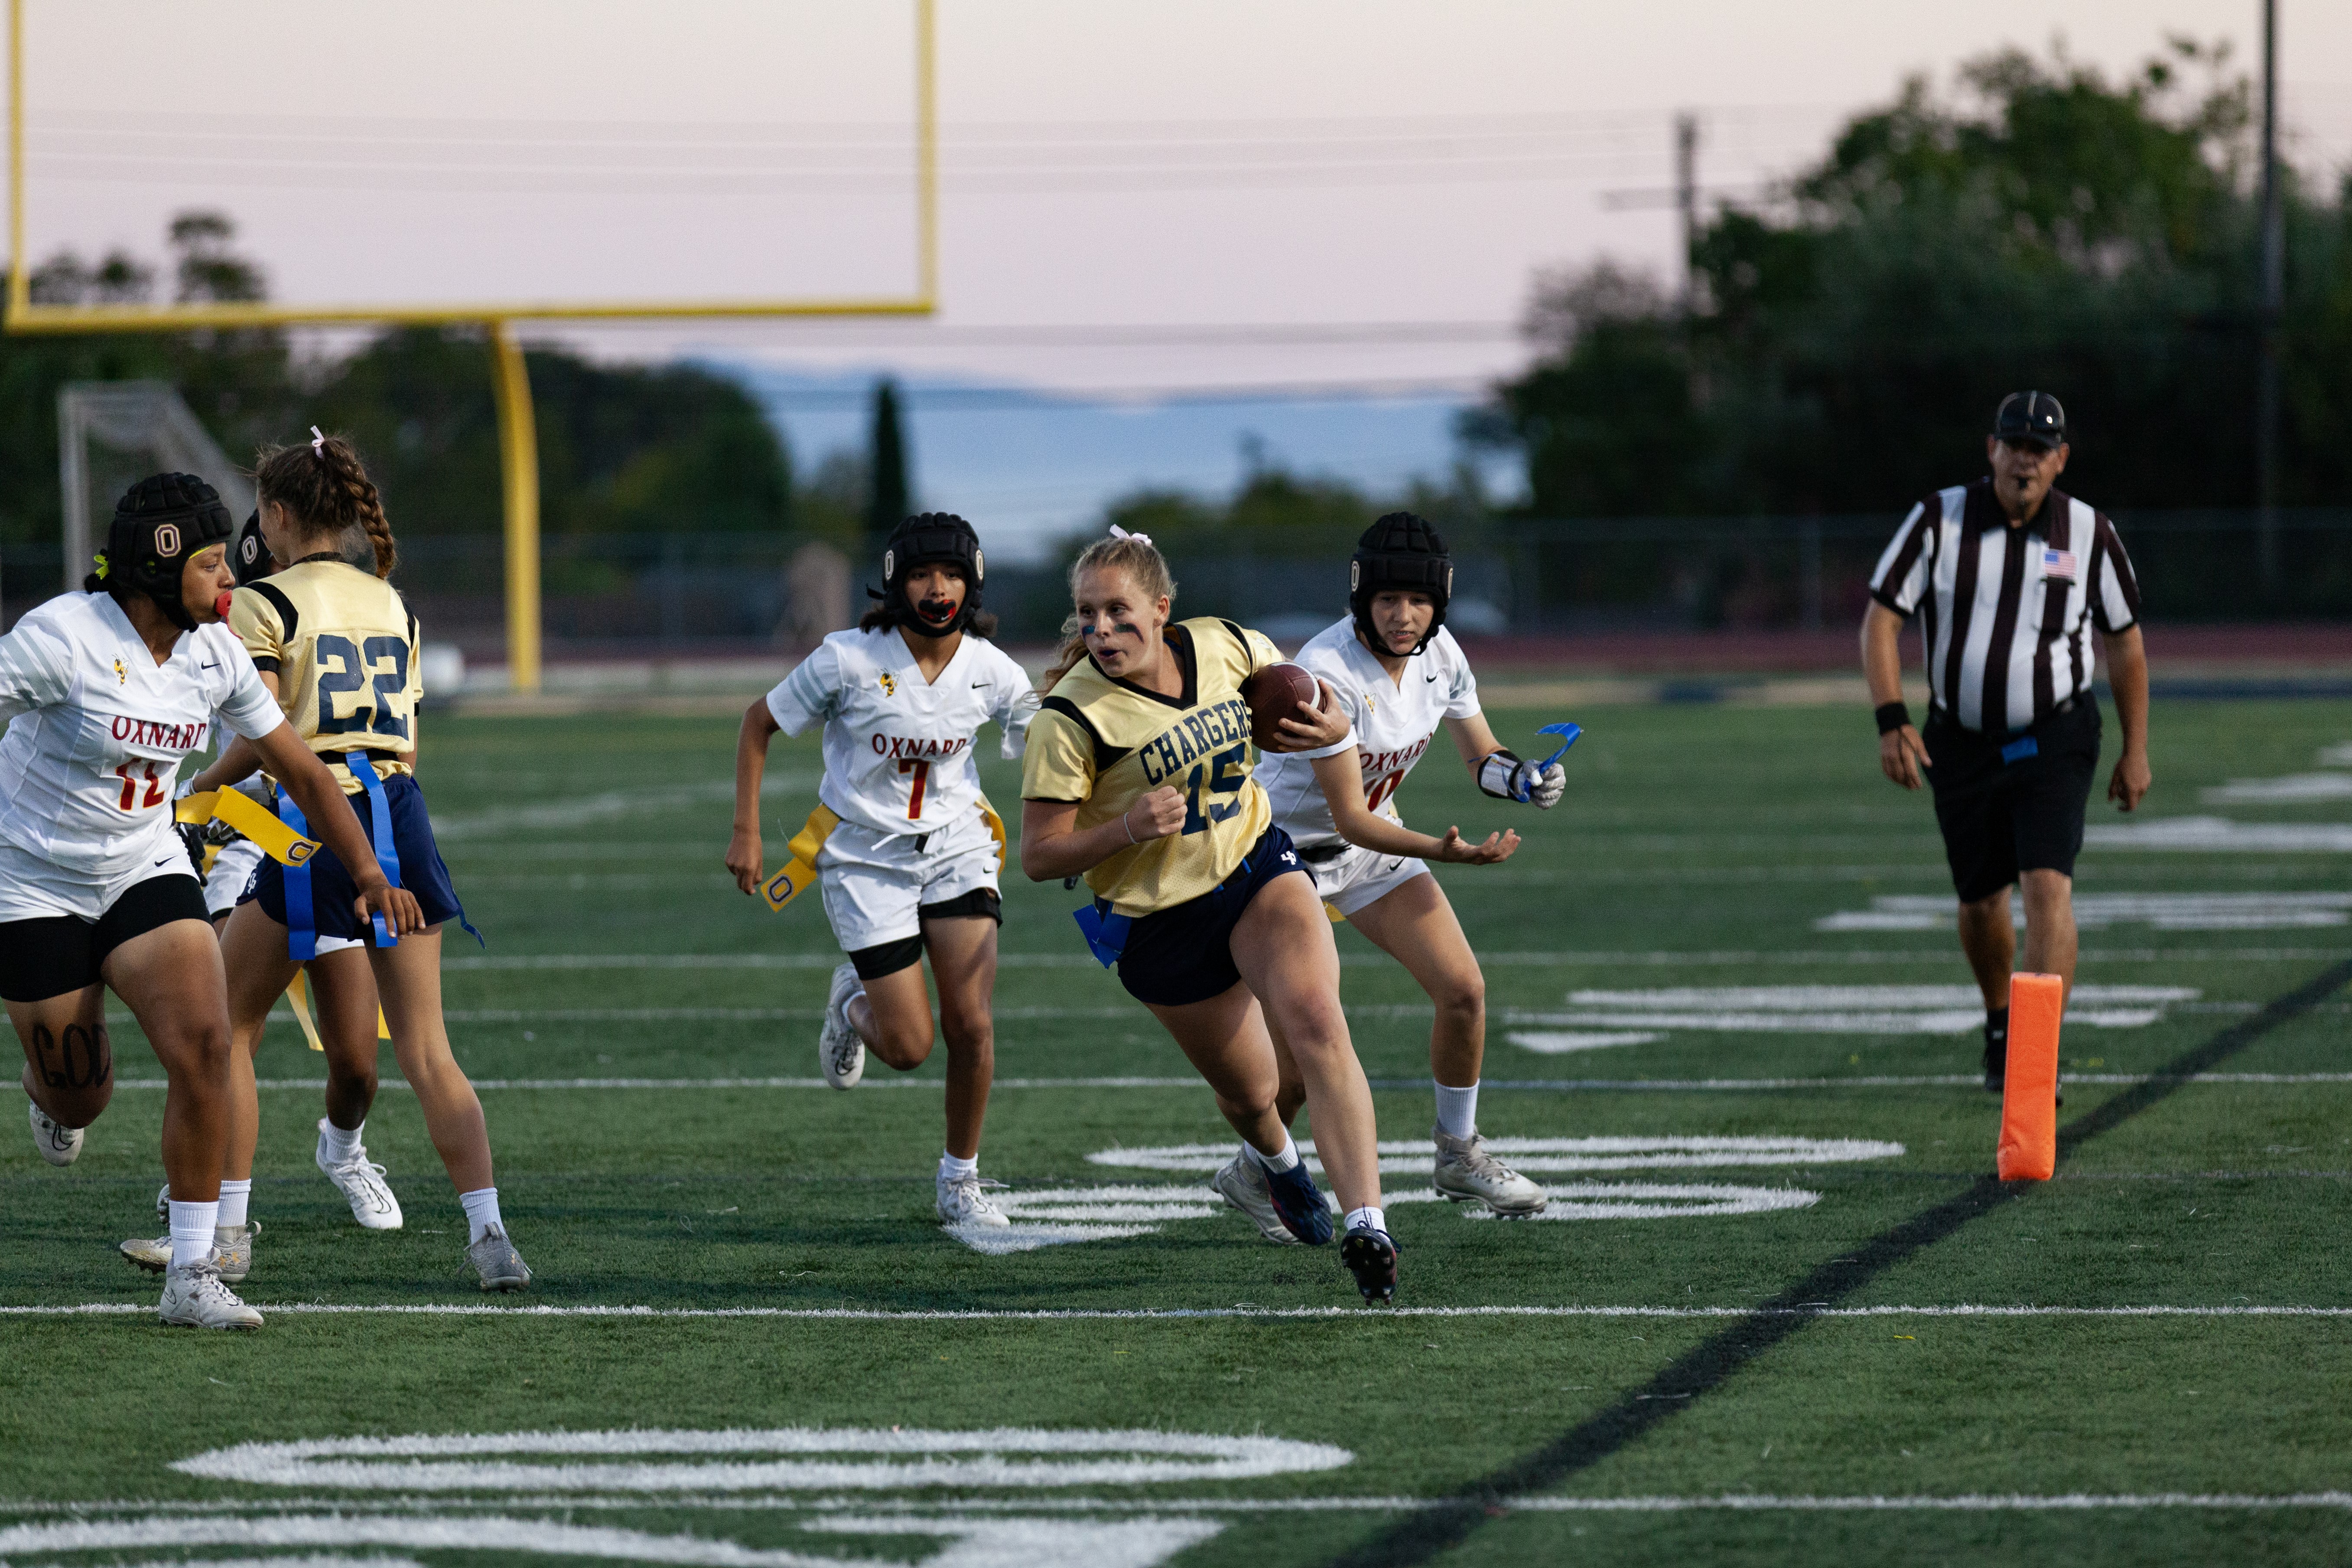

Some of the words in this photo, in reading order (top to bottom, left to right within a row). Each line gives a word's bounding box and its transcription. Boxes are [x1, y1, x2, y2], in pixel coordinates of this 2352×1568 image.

[316, 634, 409, 742] 22
[898, 758, 930, 820] 7
[1181, 742, 1246, 836] 15
